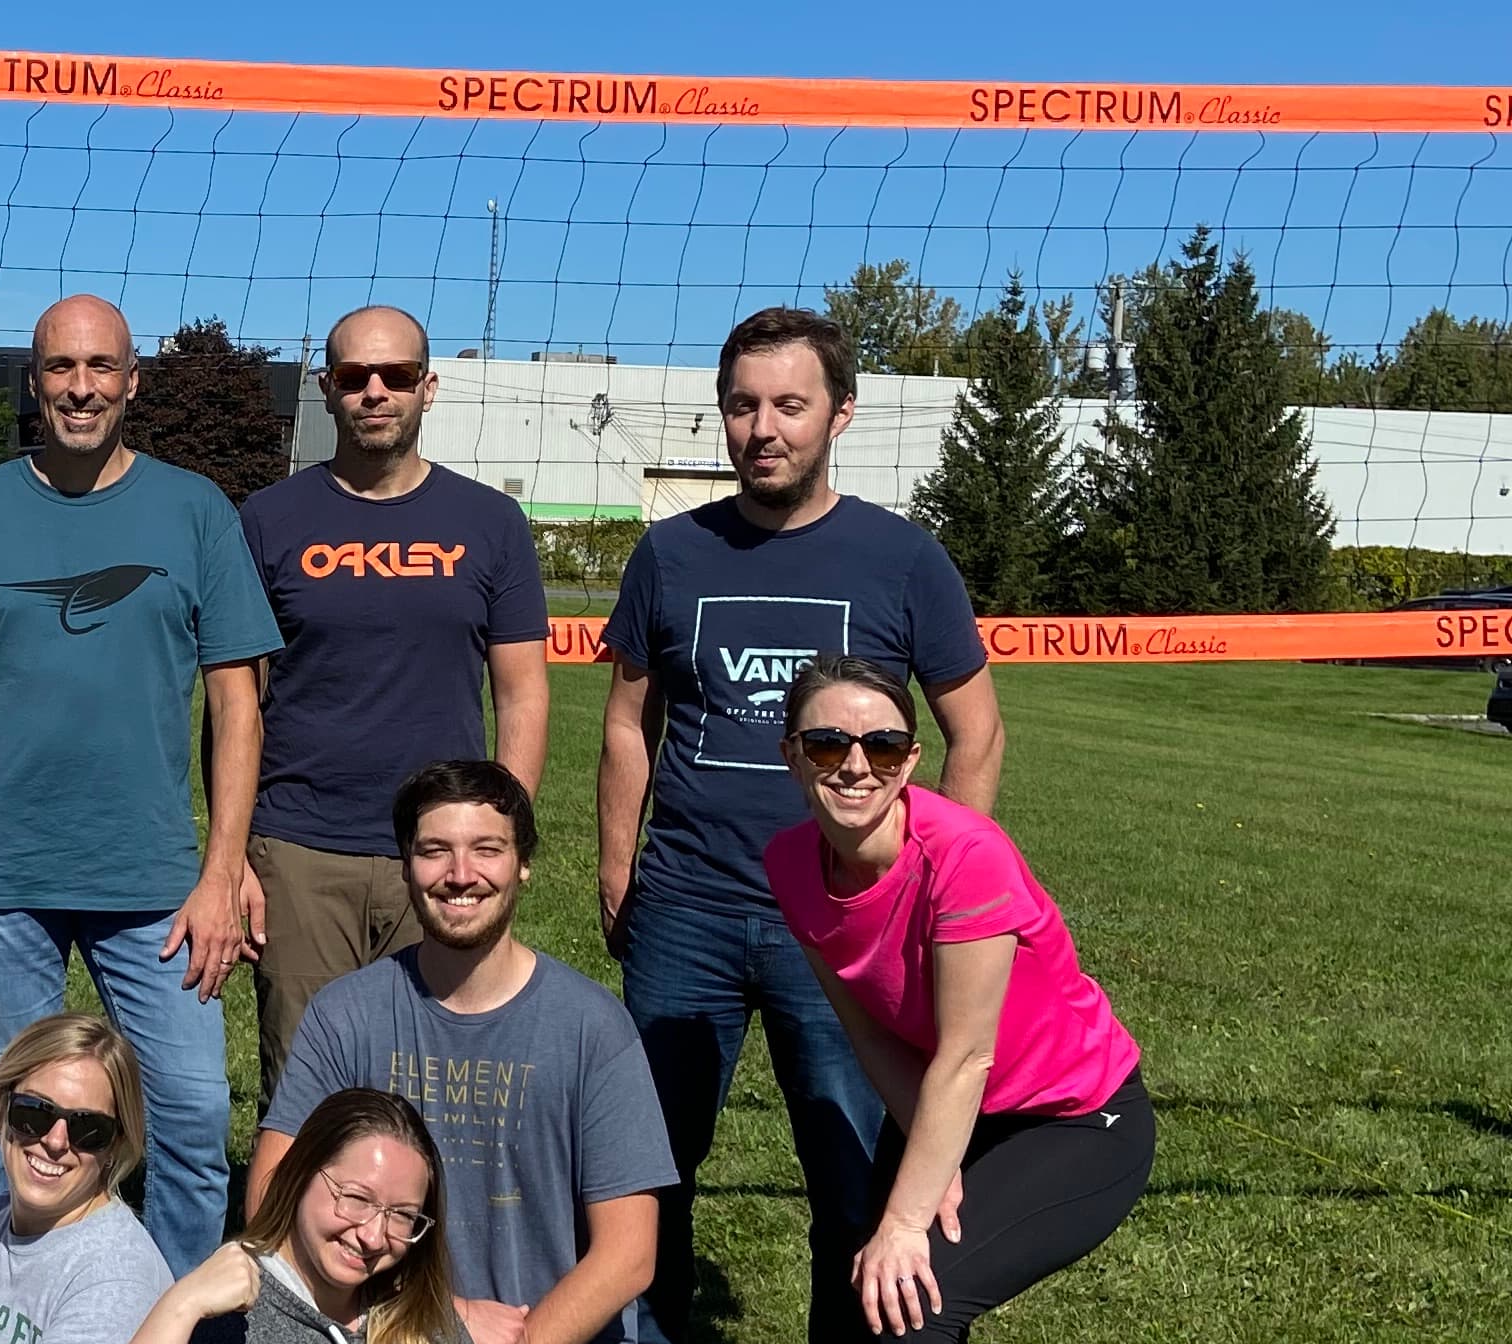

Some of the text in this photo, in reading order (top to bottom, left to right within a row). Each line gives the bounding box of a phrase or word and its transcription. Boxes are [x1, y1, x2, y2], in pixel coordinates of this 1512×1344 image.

[136, 69, 224, 101] Classic
[674, 86, 760, 117] Classic
[1198, 96, 1281, 125] Classic
[301, 542, 466, 579] OAKLEY
[1145, 626, 1228, 655] Classic
[1436, 615, 1512, 648] SPE
[754, 709, 775, 719] THE
[391, 1051, 536, 1089] ELEMENT
